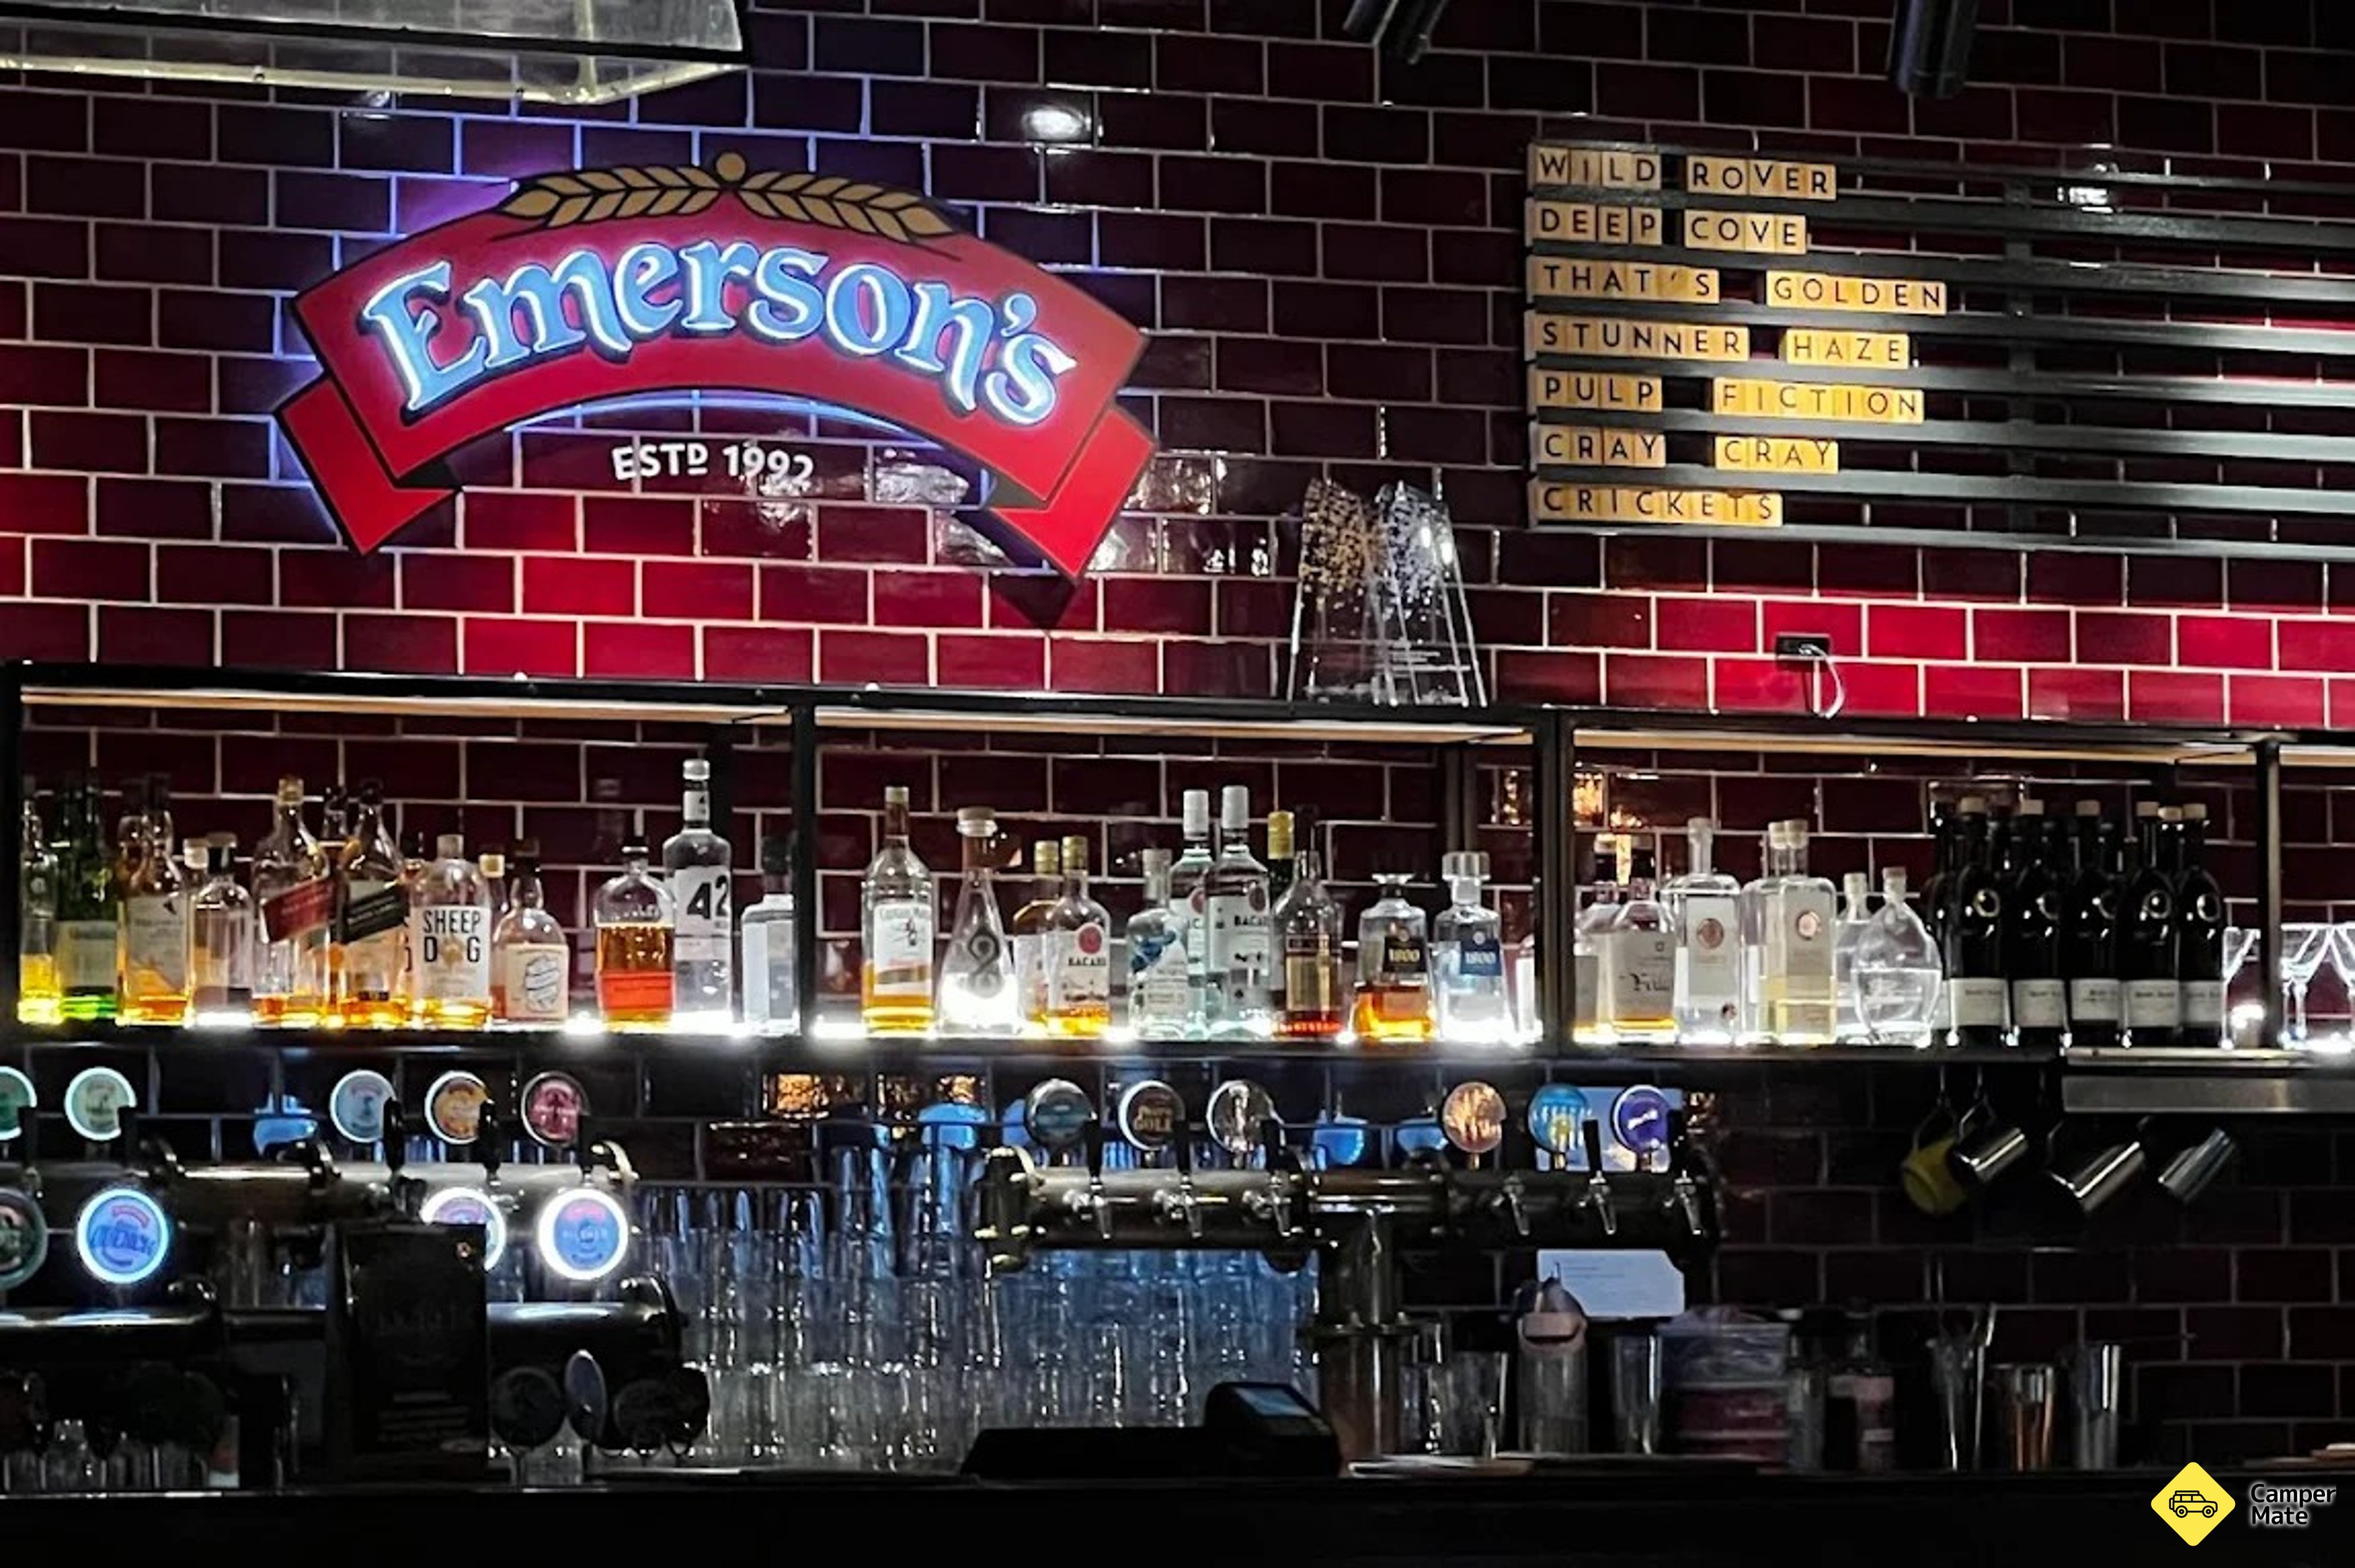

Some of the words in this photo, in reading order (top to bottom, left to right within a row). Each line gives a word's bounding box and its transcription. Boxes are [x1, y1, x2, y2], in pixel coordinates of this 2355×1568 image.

[1540, 153, 1655, 182] WILD
[1693, 164, 1826, 194] ROVER
[1541, 209, 1655, 237] DEEP
[1691, 218, 1797, 245] COVE
[1545, 265, 1710, 295] THAT'S
[1774, 279, 1939, 308] GOLDEN
[360, 241, 1077, 424] Emerson's
[1543, 323, 1740, 353] STUNNER
[1793, 336, 1901, 362] HAZE
[1545, 377, 1653, 404] PULP
[1723, 386, 1918, 416] FICTION
[612, 443, 708, 480] ESTD
[722, 444, 814, 486] 1992
[1545, 434, 1658, 459] CRAY
[1724, 441, 1830, 466] CRAY
[1544, 488, 1772, 520] CRICKETS
[686, 875, 728, 919] 42
[423, 910, 481, 934] SHEEP
[424, 936, 480, 962] DG
